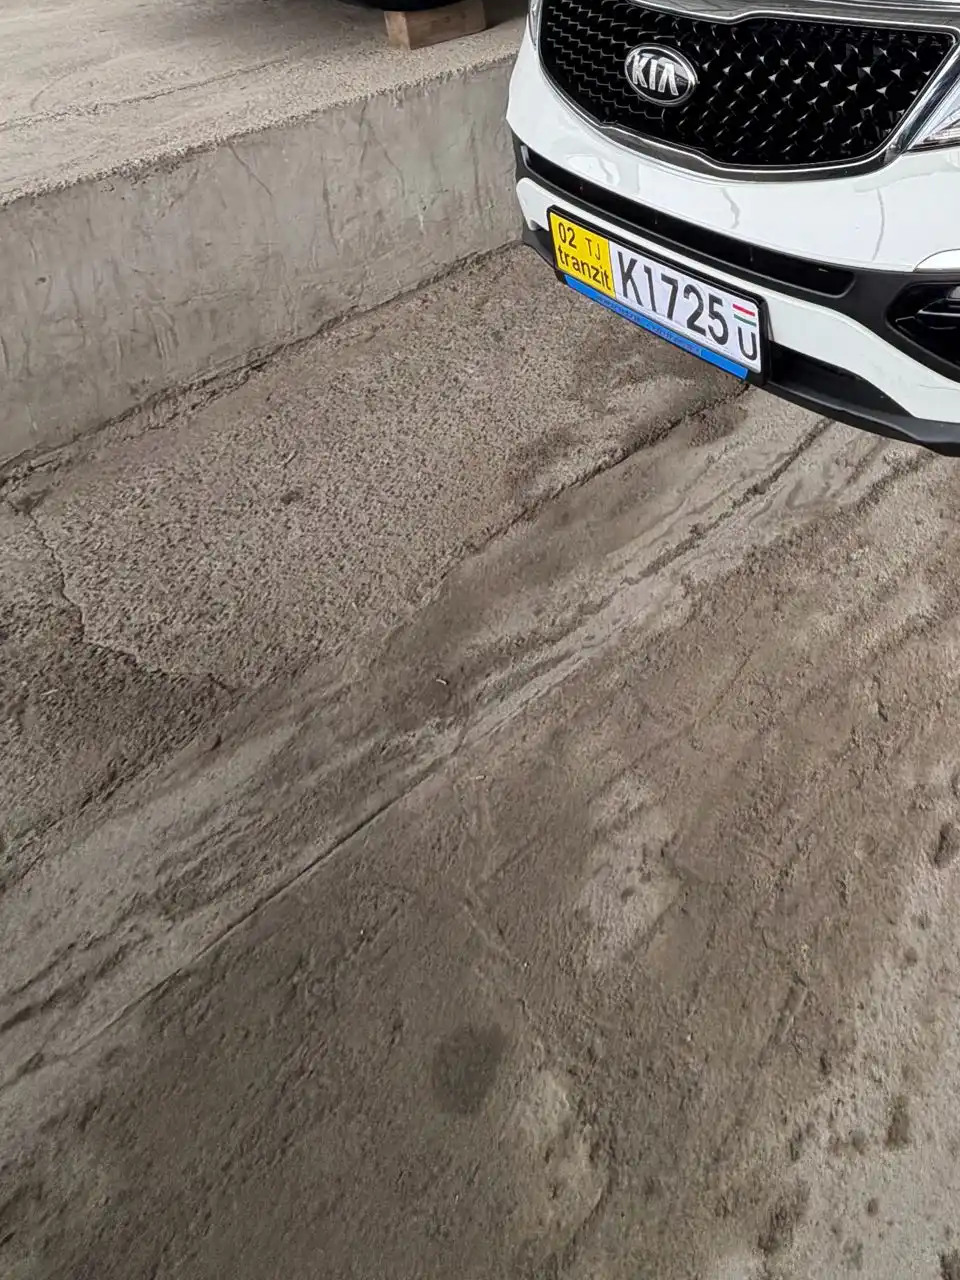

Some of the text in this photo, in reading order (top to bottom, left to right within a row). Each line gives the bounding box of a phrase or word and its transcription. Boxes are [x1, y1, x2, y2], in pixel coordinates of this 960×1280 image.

[632, 52, 679, 96] KIA
[558, 222, 601, 261] 02 TJ
[557, 246, 612, 291] tranzit
[616, 250, 729, 346] K1725
[737, 325, 758, 361] U
